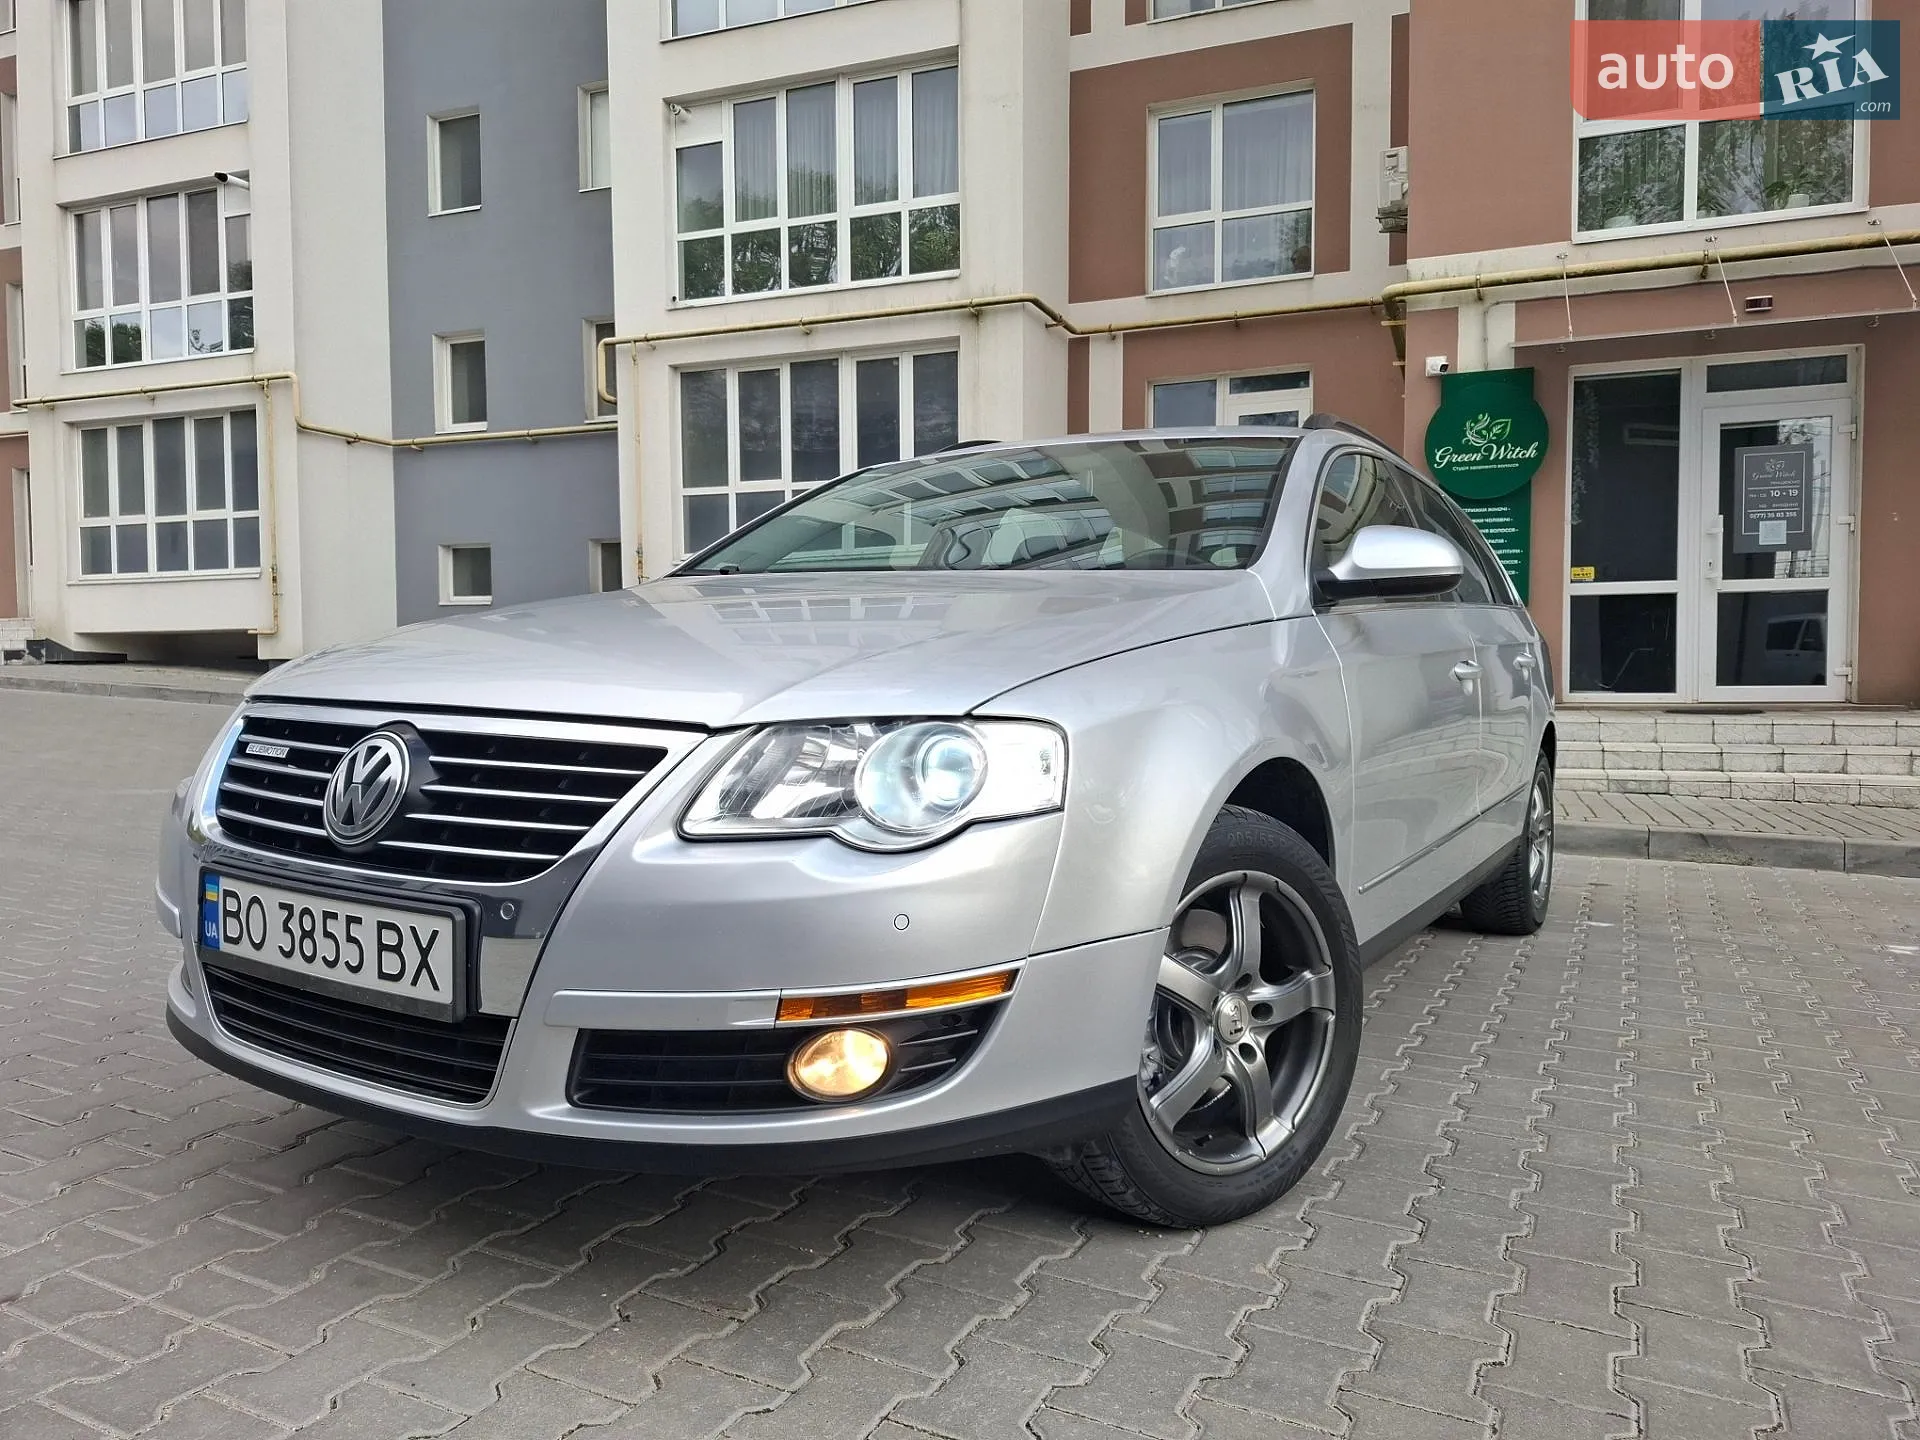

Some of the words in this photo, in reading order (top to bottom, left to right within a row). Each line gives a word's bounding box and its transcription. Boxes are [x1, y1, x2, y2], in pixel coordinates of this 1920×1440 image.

[1434, 446, 1483, 469] Green
[1481, 441, 1539, 460] Witch
[204, 919, 218, 939] UA
[222, 887, 267, 951] BO
[277, 901, 365, 974] 3855
[376, 919, 440, 991] BX
